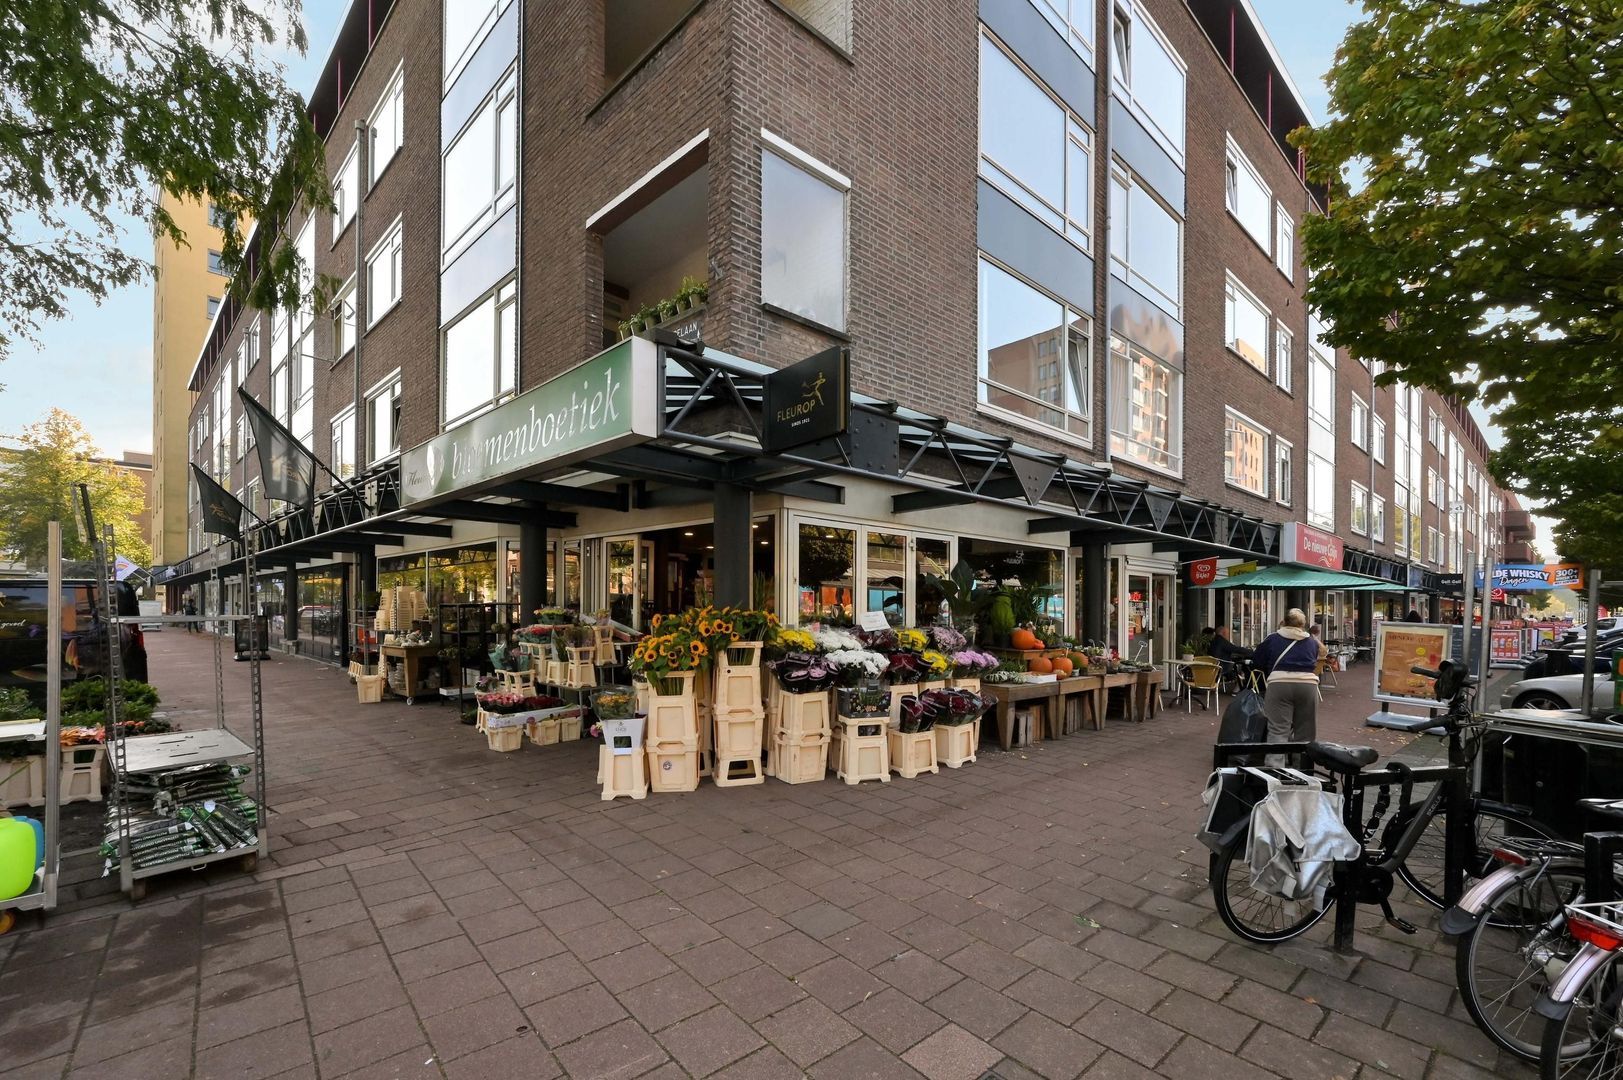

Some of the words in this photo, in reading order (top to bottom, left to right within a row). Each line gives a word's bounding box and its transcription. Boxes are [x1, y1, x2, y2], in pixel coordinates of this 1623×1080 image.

[776, 399, 816, 422] FLEUROP
[452, 367, 620, 480] bmenboetiek
[1478, 569, 1509, 580] LDE
[1509, 569, 1550, 581] WHISKY
[1555, 568, 1578, 577] 300+
